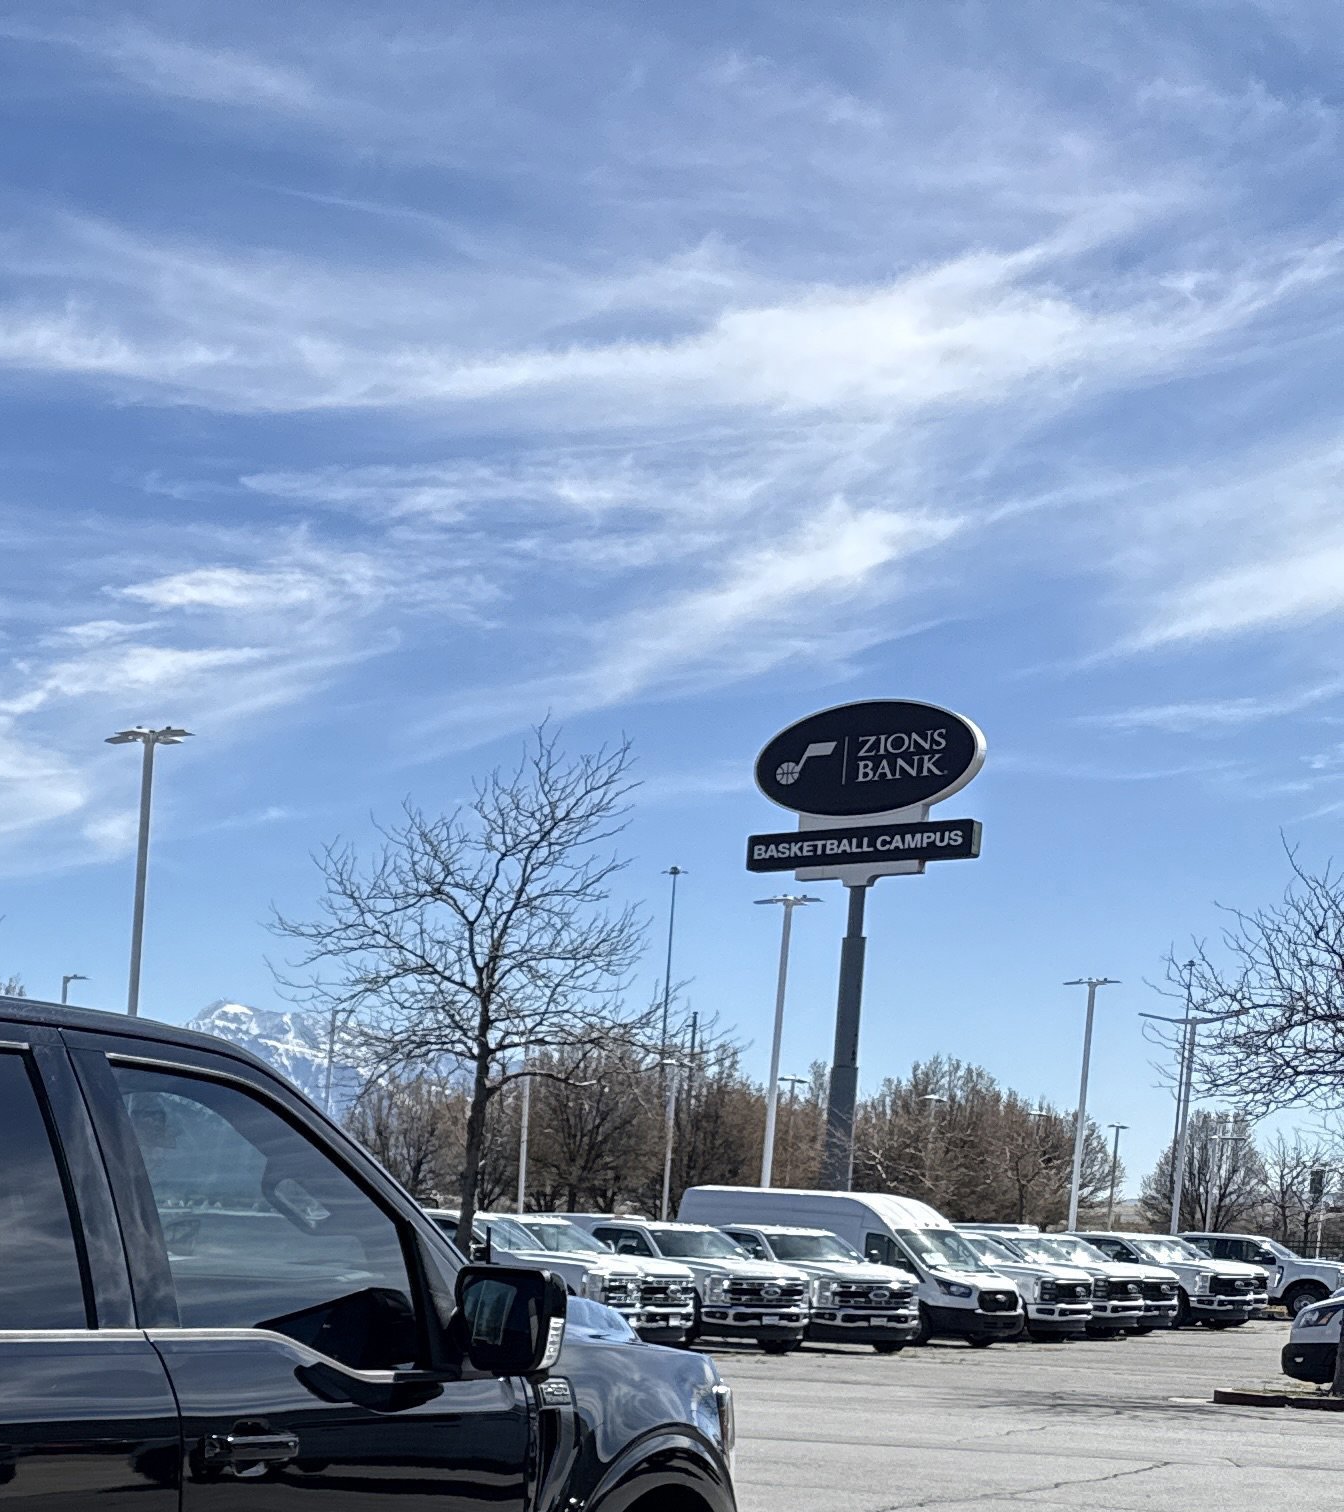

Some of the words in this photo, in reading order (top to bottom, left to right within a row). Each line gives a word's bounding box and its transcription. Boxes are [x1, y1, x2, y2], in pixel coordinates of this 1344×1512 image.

[857, 728, 947, 757] ZIONS
[855, 753, 945, 783] BANK
[752, 836, 874, 860] BASKETBALL
[875, 830, 963, 850] CAMPUS
